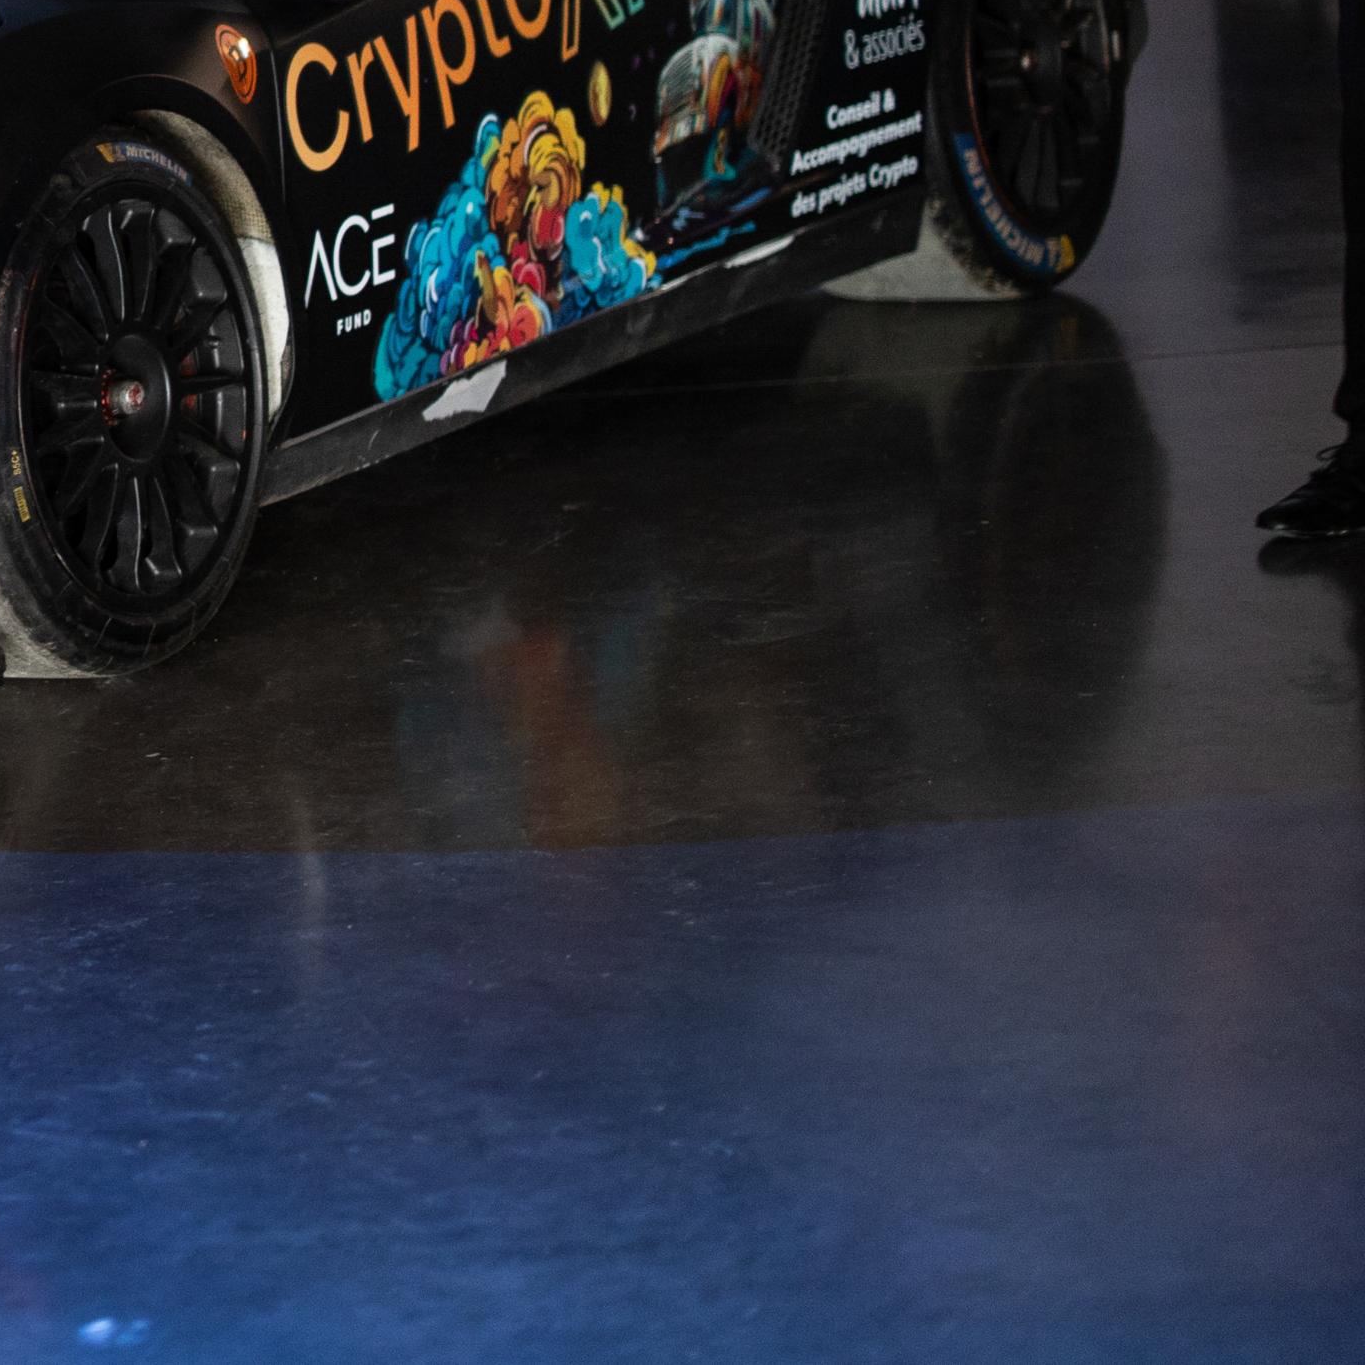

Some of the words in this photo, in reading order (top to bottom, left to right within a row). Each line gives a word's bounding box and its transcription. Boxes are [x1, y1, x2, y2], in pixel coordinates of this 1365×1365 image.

[844, 29, 860, 70] &
[861, 11, 926, 65] associés
[826, 90, 881, 130] Conseil
[125, 144, 189, 182] MICHELIN
[790, 110, 923, 176] Accompagnement
[790, 191, 817, 219] des
[817, 173, 867, 214] projets
[869, 155, 919, 190] Crypto
[963, 148, 1045, 266] MICHELIN
[304, 203, 396, 310] ACE
[336, 308, 372, 336] FUND
